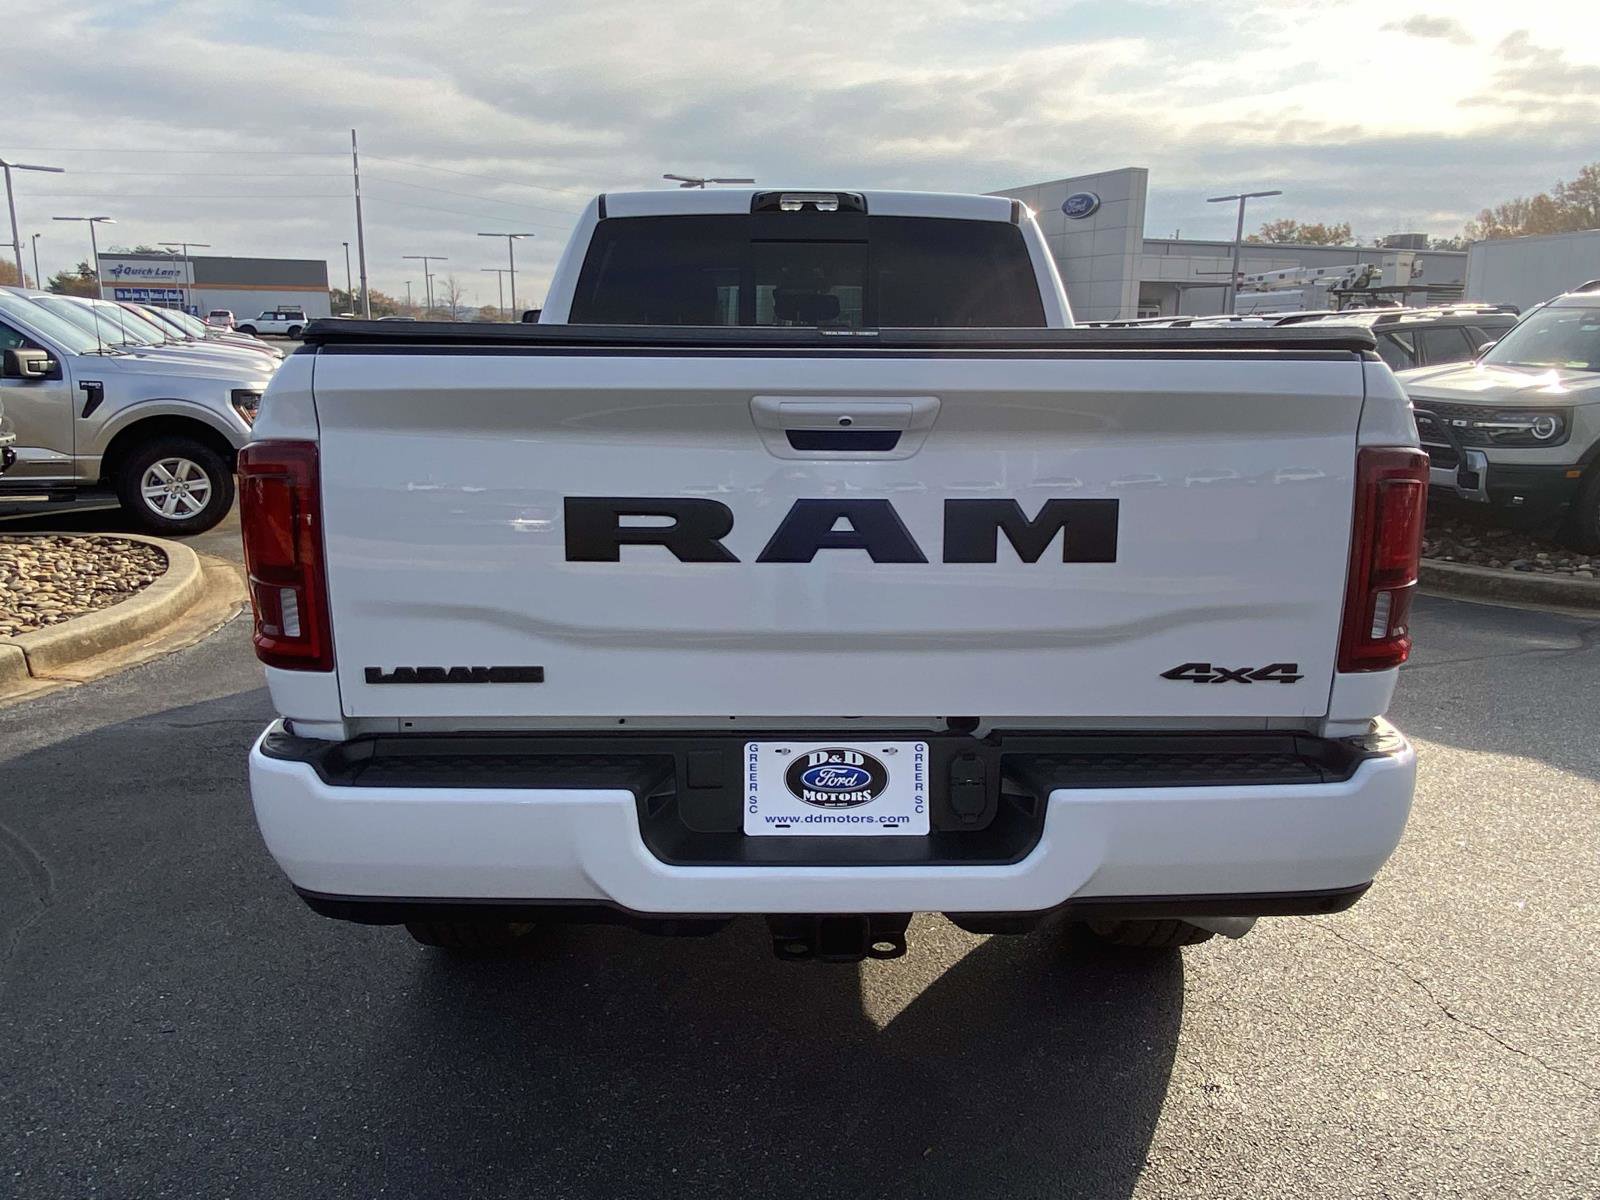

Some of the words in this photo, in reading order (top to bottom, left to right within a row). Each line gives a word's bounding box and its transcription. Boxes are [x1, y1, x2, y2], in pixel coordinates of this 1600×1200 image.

[124, 267, 152, 277] Quick
[155, 267, 181, 277] Lane
[564, 496, 1120, 564] RAM
[749, 743, 759, 792] GREER
[807, 750, 865, 767] D&D
[914, 743, 924, 791] GREER
[815, 768, 859, 787] Ford
[749, 795, 758, 814] SC
[802, 789, 872, 802] MOTORS
[914, 795, 924, 814] SC
[765, 814, 910, 824] www.ddmotors.com
